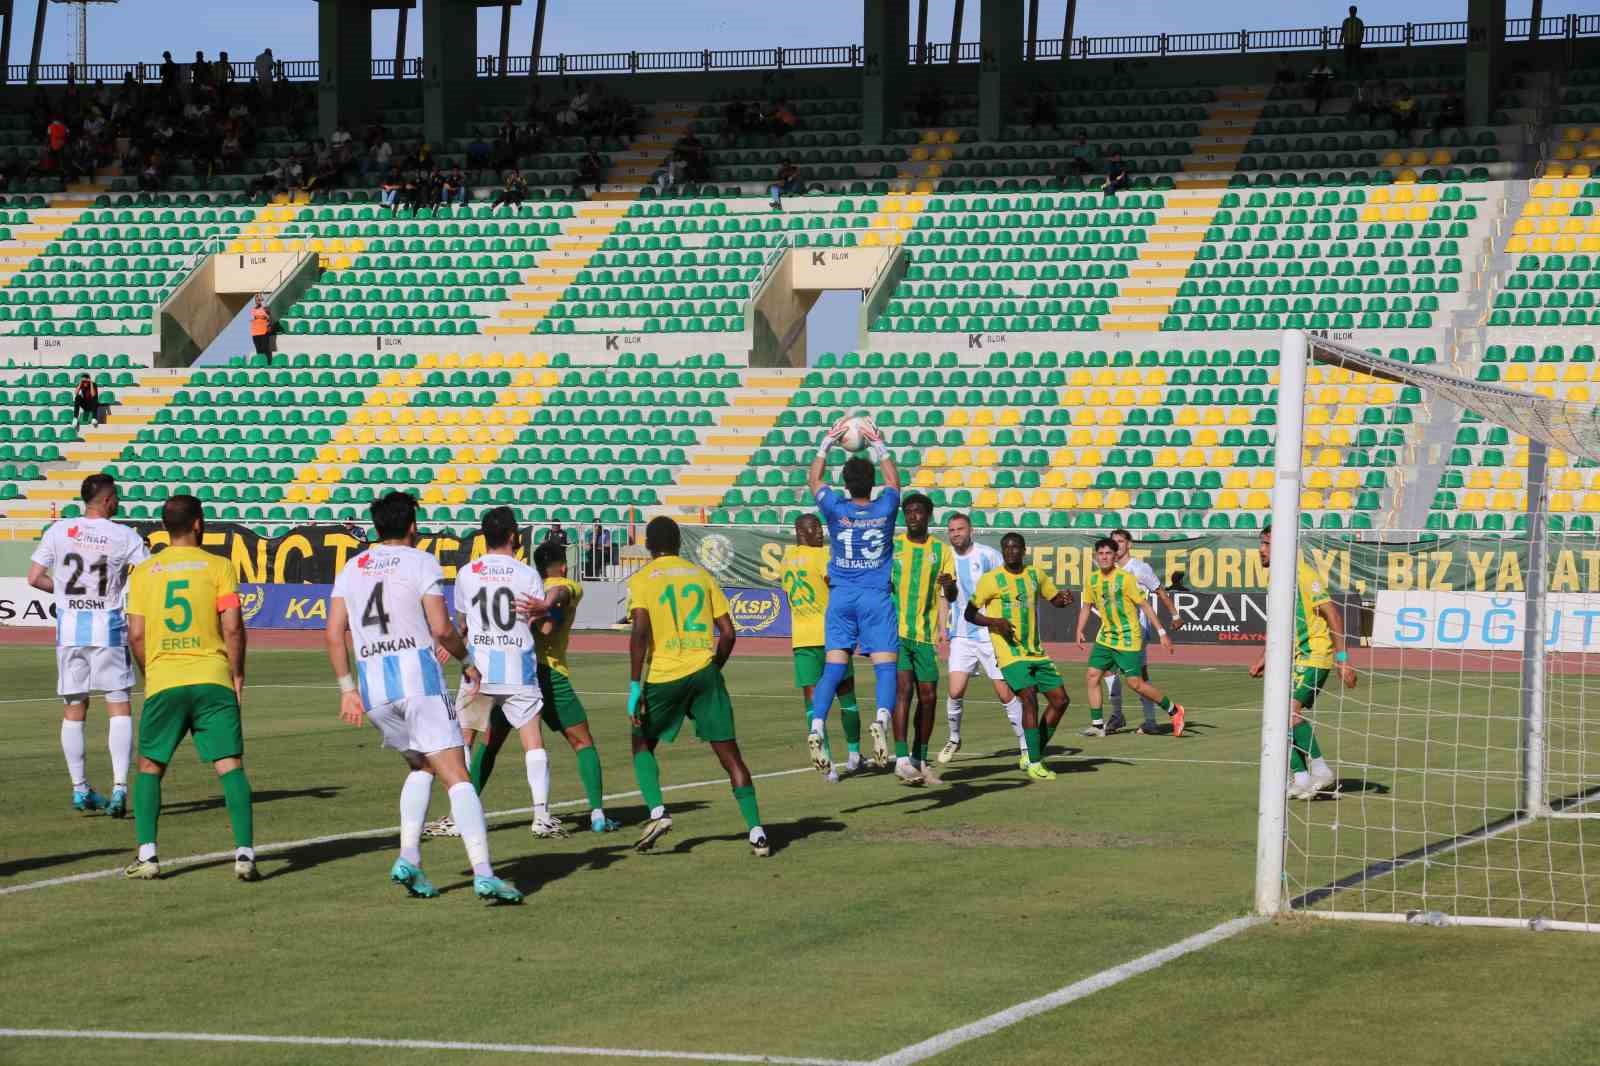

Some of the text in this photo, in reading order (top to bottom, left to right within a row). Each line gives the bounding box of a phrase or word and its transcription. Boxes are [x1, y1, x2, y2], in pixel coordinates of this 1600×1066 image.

[812, 251, 826, 266] K
[606, 335, 619, 351] K
[969, 334, 983, 349] K
[836, 528, 885, 560] 13
[64, 553, 109, 597] 21
[783, 568, 816, 607] 25
[164, 579, 193, 633] 5
[361, 581, 390, 634] 4
[471, 586, 517, 632] 10
[658, 583, 707, 633] 12
[735, 600, 773, 614] KSP
[162, 636, 201, 650] EREN
